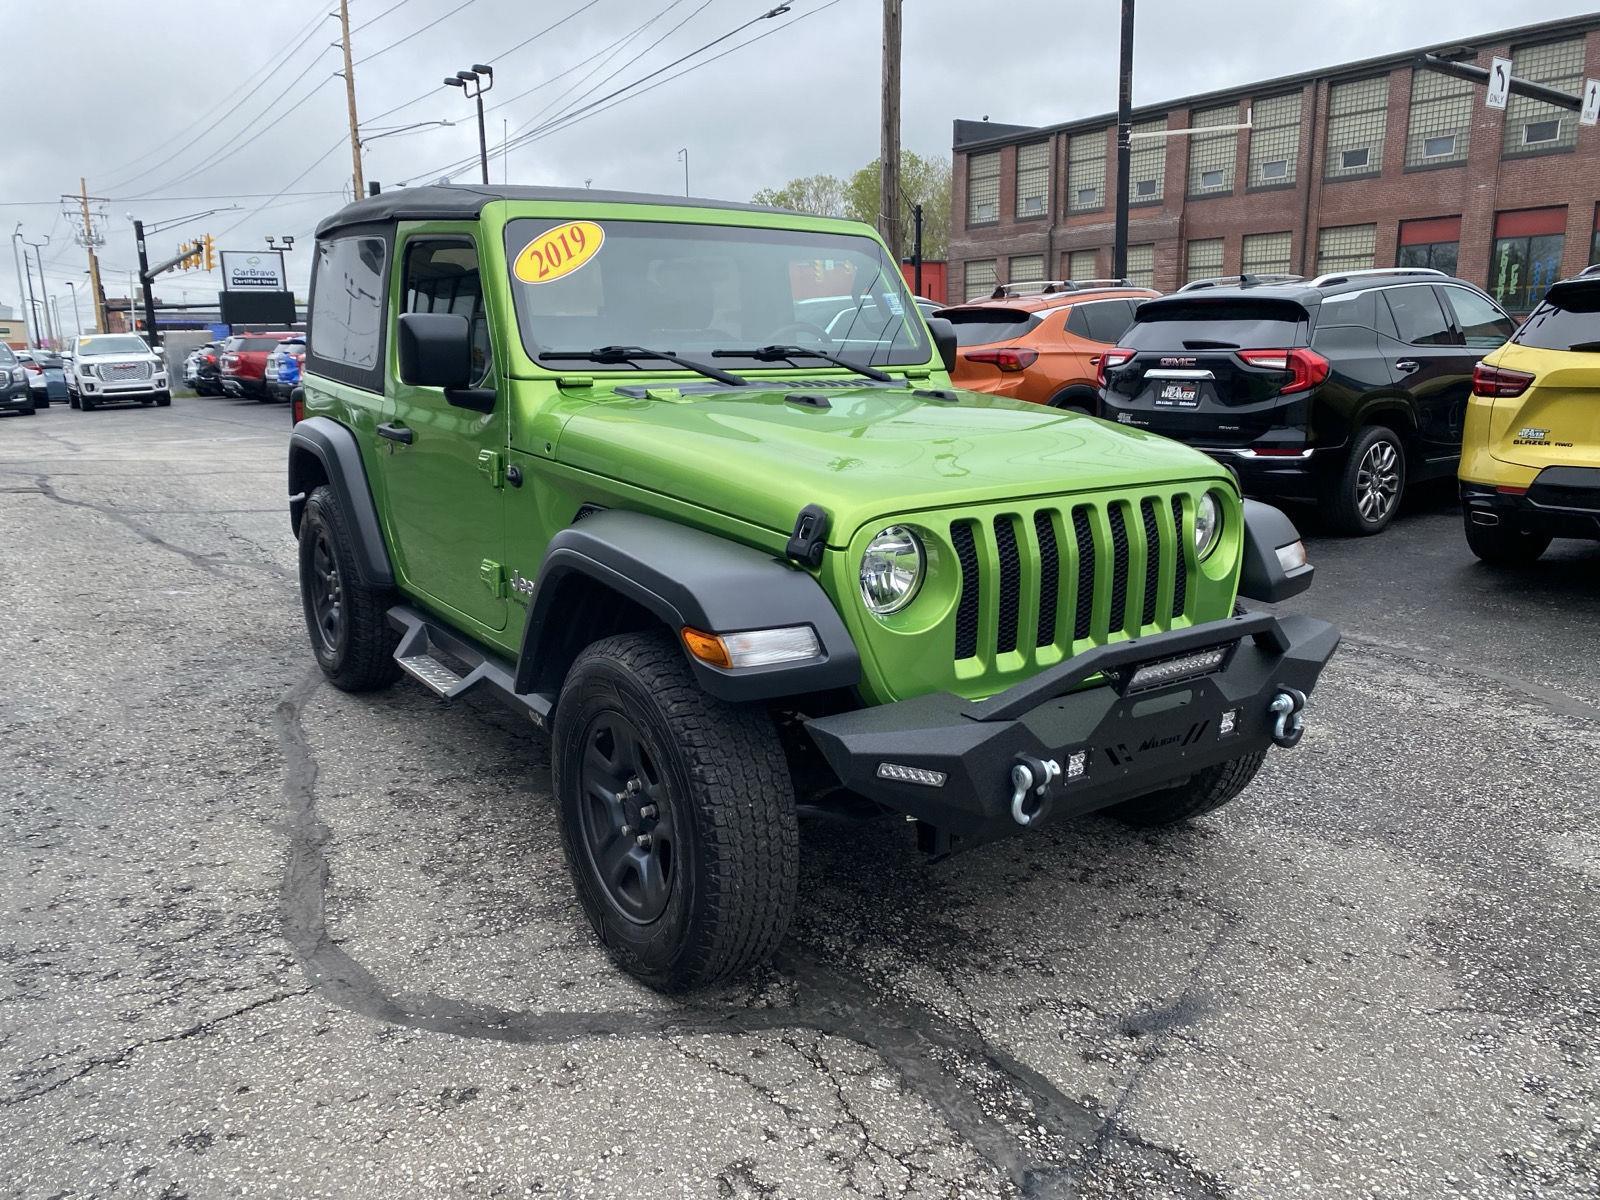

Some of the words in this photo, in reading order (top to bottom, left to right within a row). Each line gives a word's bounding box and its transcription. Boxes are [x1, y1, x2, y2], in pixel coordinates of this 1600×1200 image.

[1489, 93, 1505, 104] ONLY
[530, 226, 586, 278] 2019
[233, 268, 276, 276] CarBravo
[1160, 357, 1197, 366] GMC
[1161, 391, 1196, 399] WEAVER
[510, 569, 536, 595] Jee
